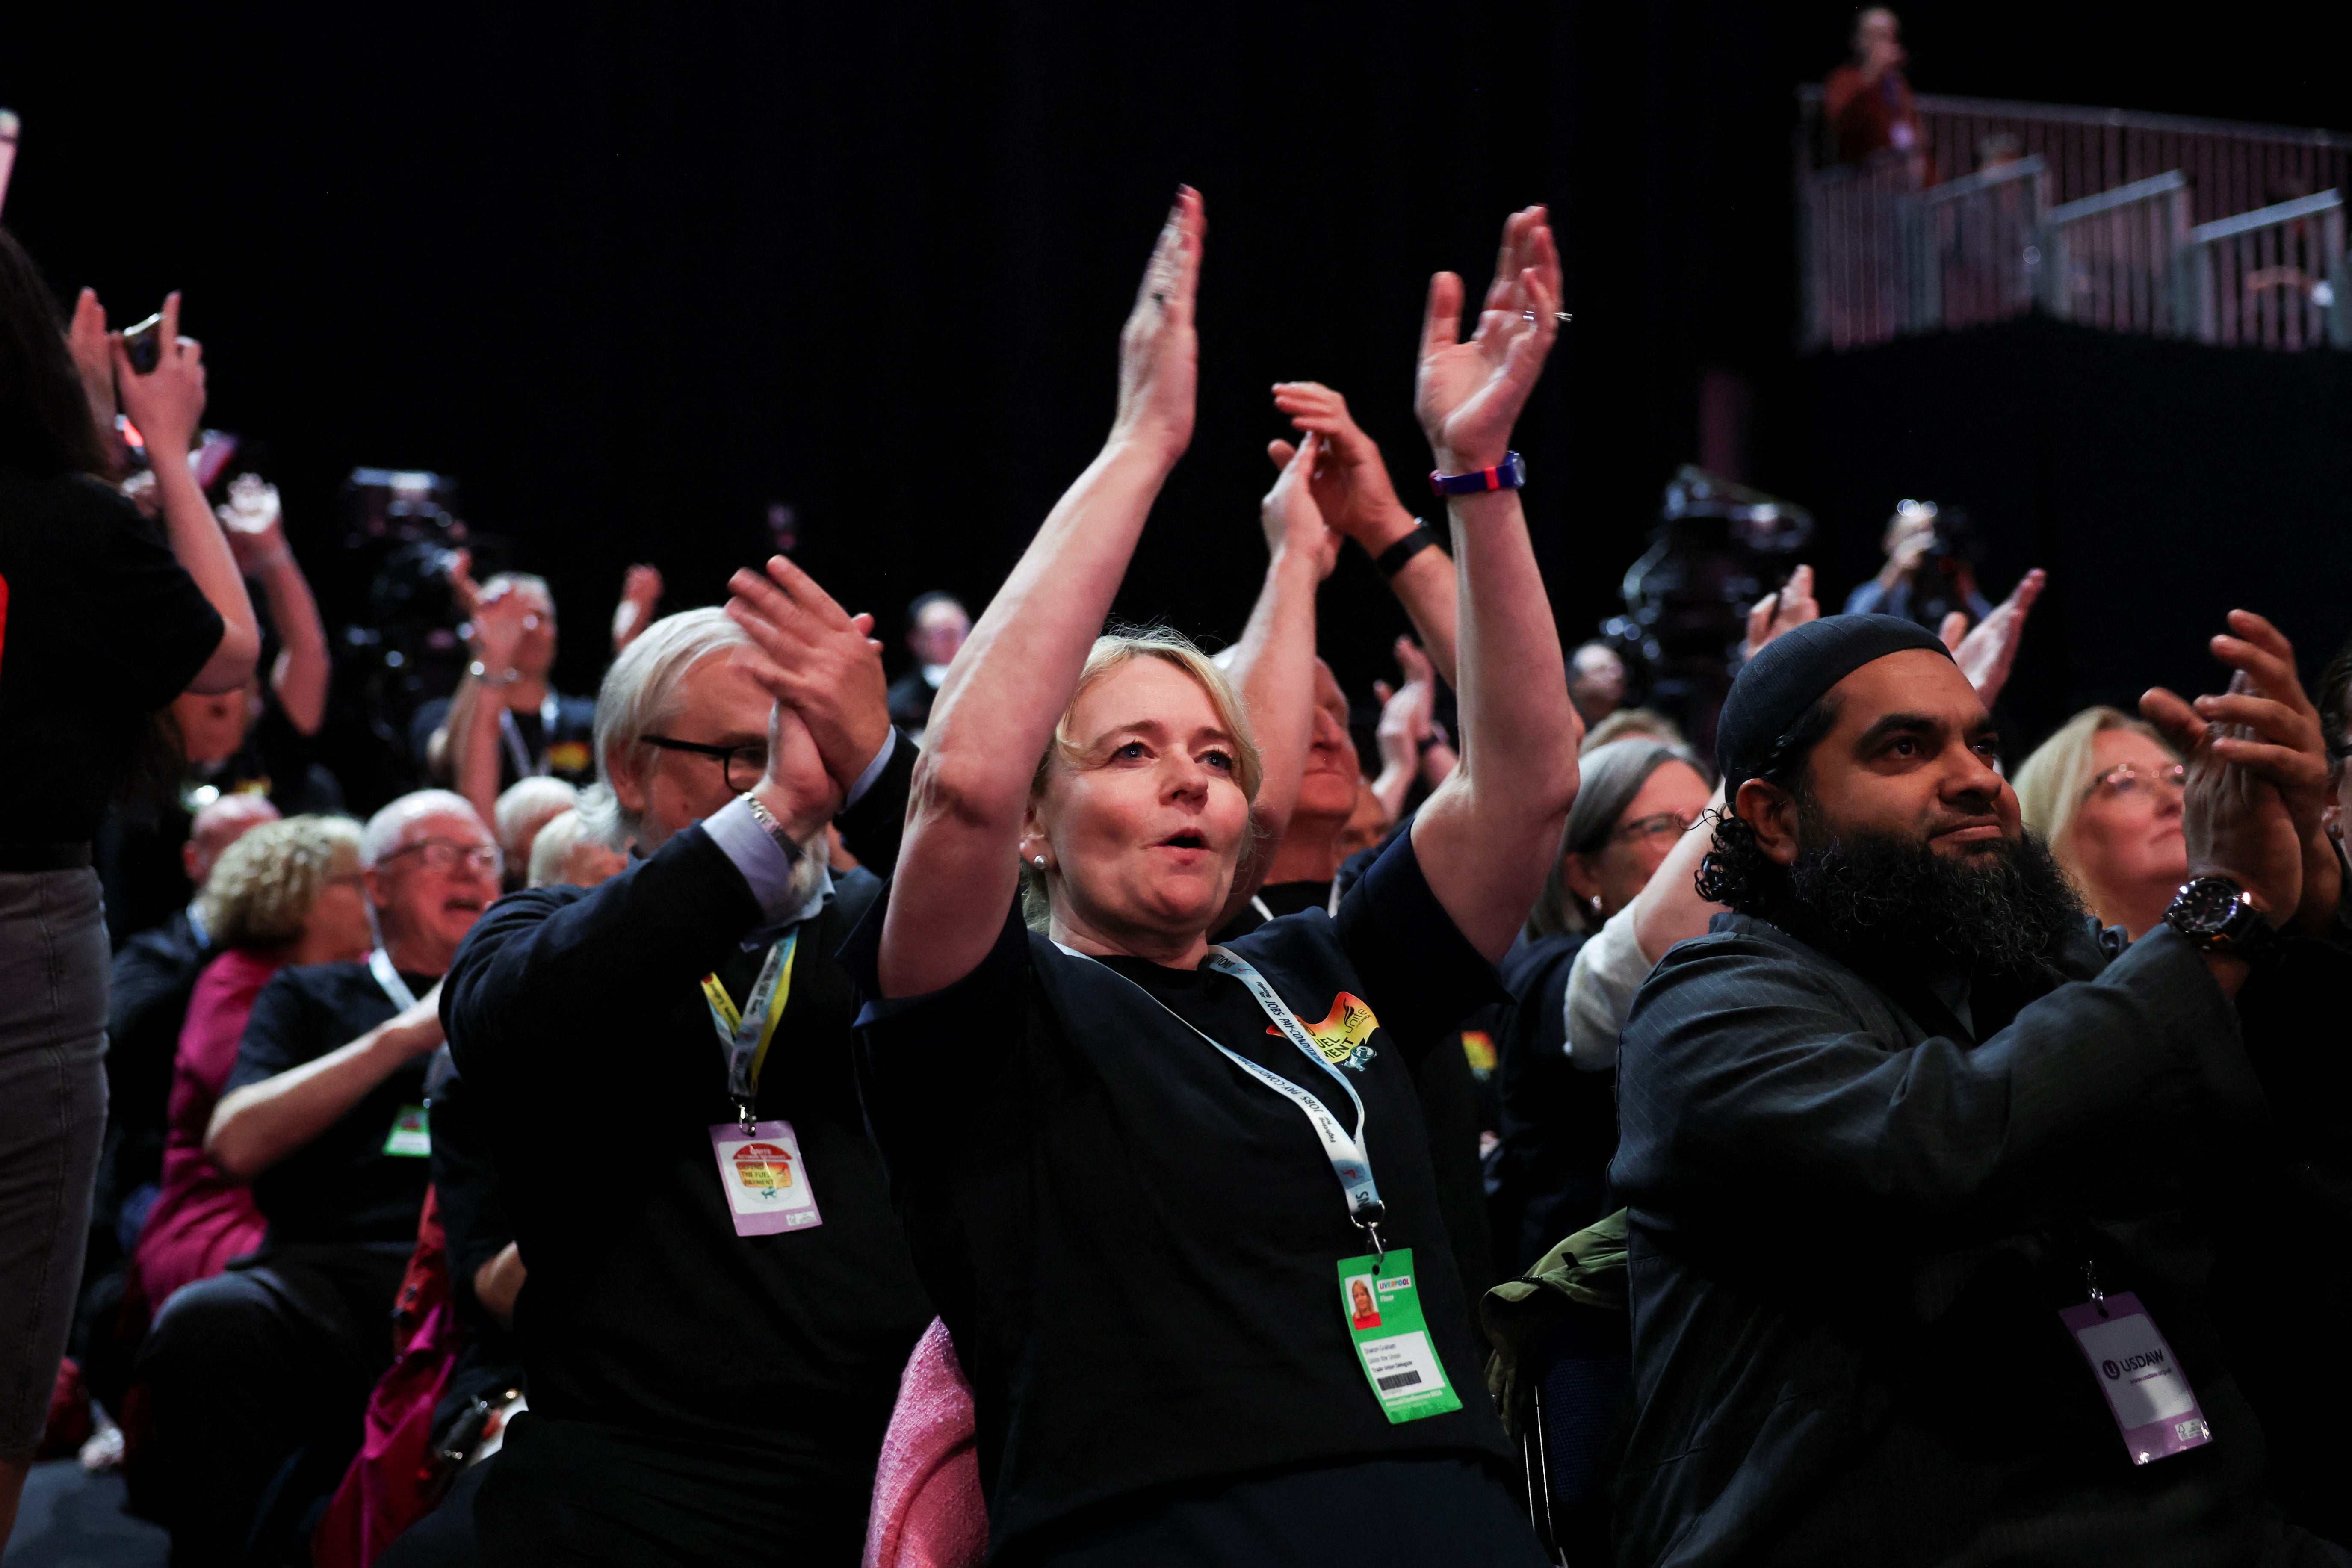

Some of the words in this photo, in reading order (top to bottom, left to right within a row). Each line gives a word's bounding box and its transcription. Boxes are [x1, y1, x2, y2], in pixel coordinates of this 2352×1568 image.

[1312, 1036, 1341, 1048] UEL
[1318, 1117, 1336, 1143] Fighting
[2119, 1349, 2164, 1372] USDAW
